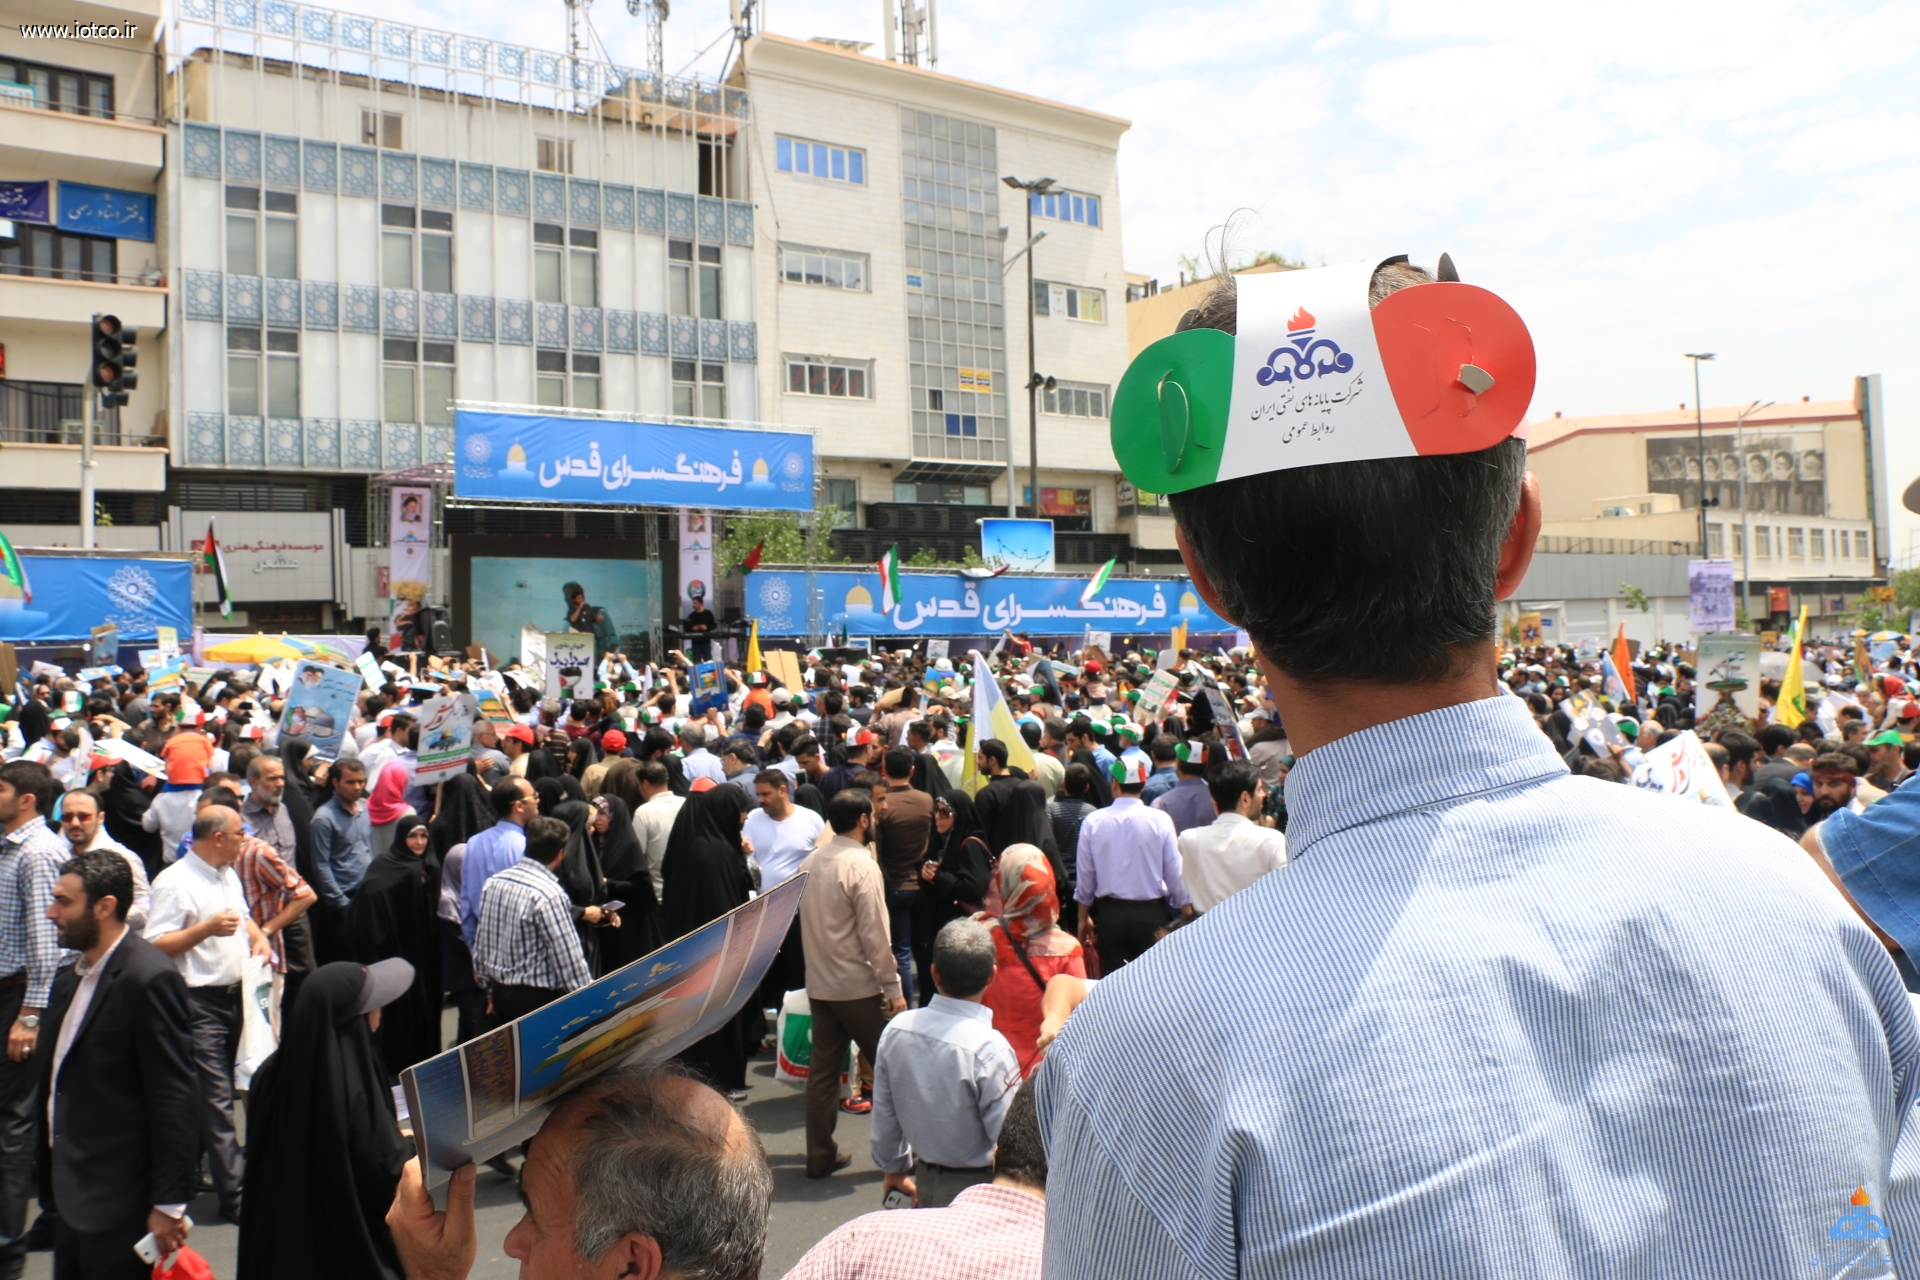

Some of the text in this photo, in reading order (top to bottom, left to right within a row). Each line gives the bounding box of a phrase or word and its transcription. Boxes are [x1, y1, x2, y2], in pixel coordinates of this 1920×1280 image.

[1331, 370, 1364, 406] شرکت
[1251, 403, 1276, 422] ایران
[1276, 386, 1295, 416] نفتی
[1295, 391, 1312, 413] های
[1282, 421, 1335, 444] روابط عمومی
[539, 441, 743, 492] فرهنگسرای قدس
[223, 541, 249, 554] هنری
[250, 540, 287, 553] فرهنگی
[893, 581, 1167, 631] فرهنگسرای قدس
